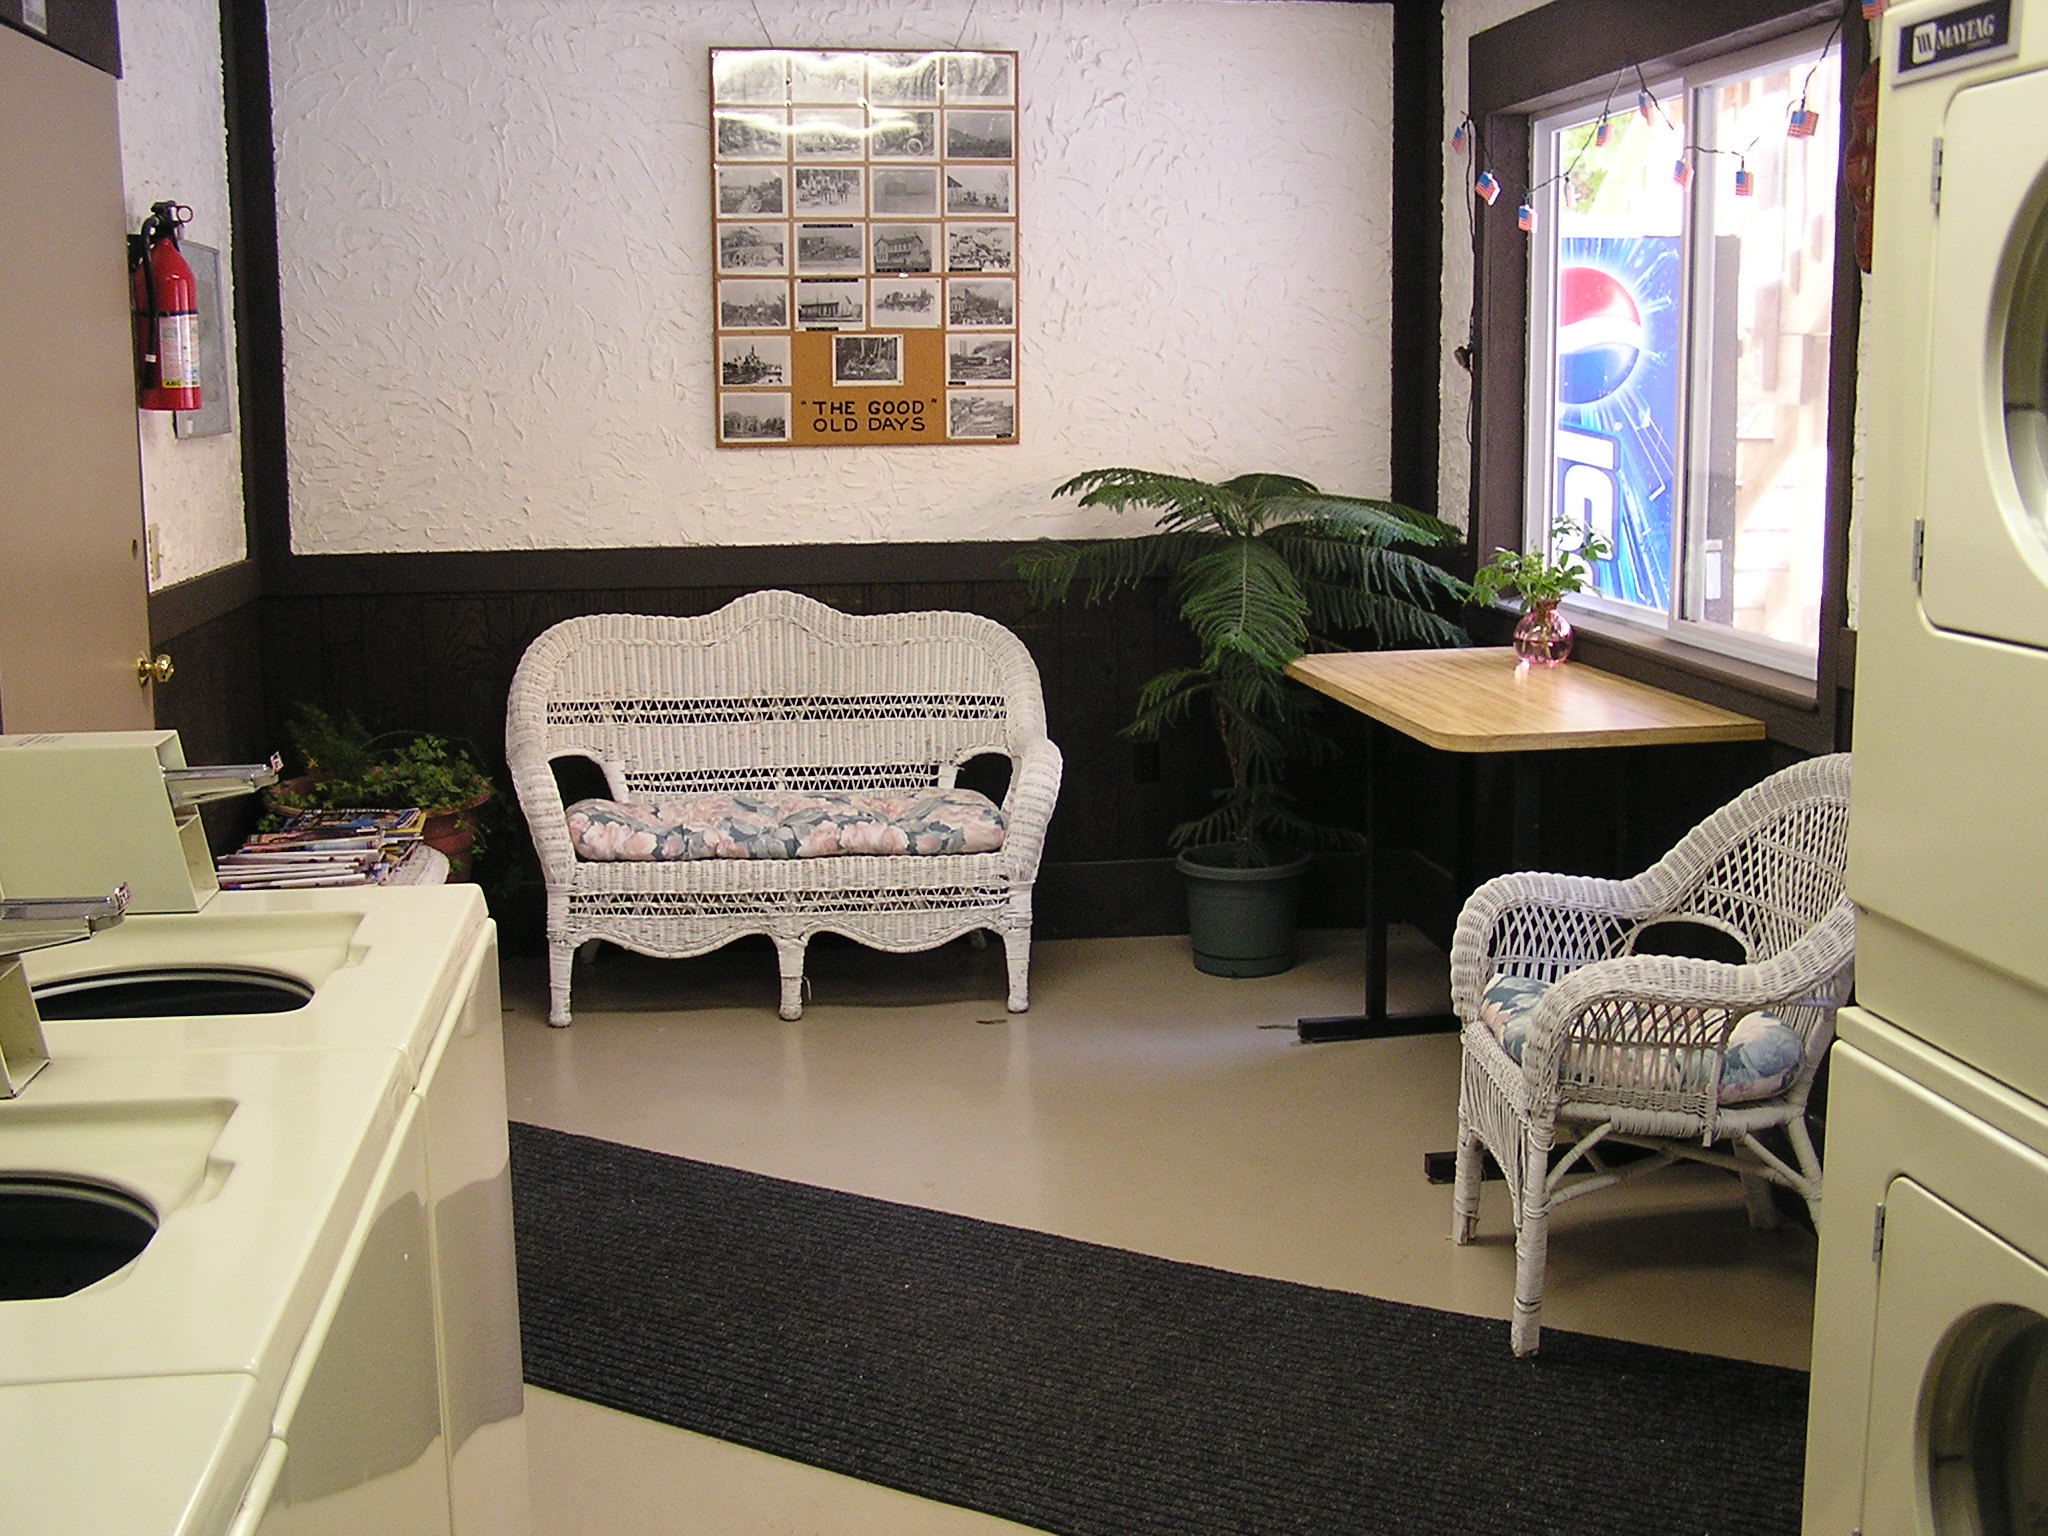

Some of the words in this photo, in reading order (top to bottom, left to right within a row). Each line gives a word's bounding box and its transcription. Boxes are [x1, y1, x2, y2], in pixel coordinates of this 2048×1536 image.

[1936, 14, 1995, 50] MAYTAG
[813, 418, 858, 432] OLD
[868, 417, 926, 431] DAYS
